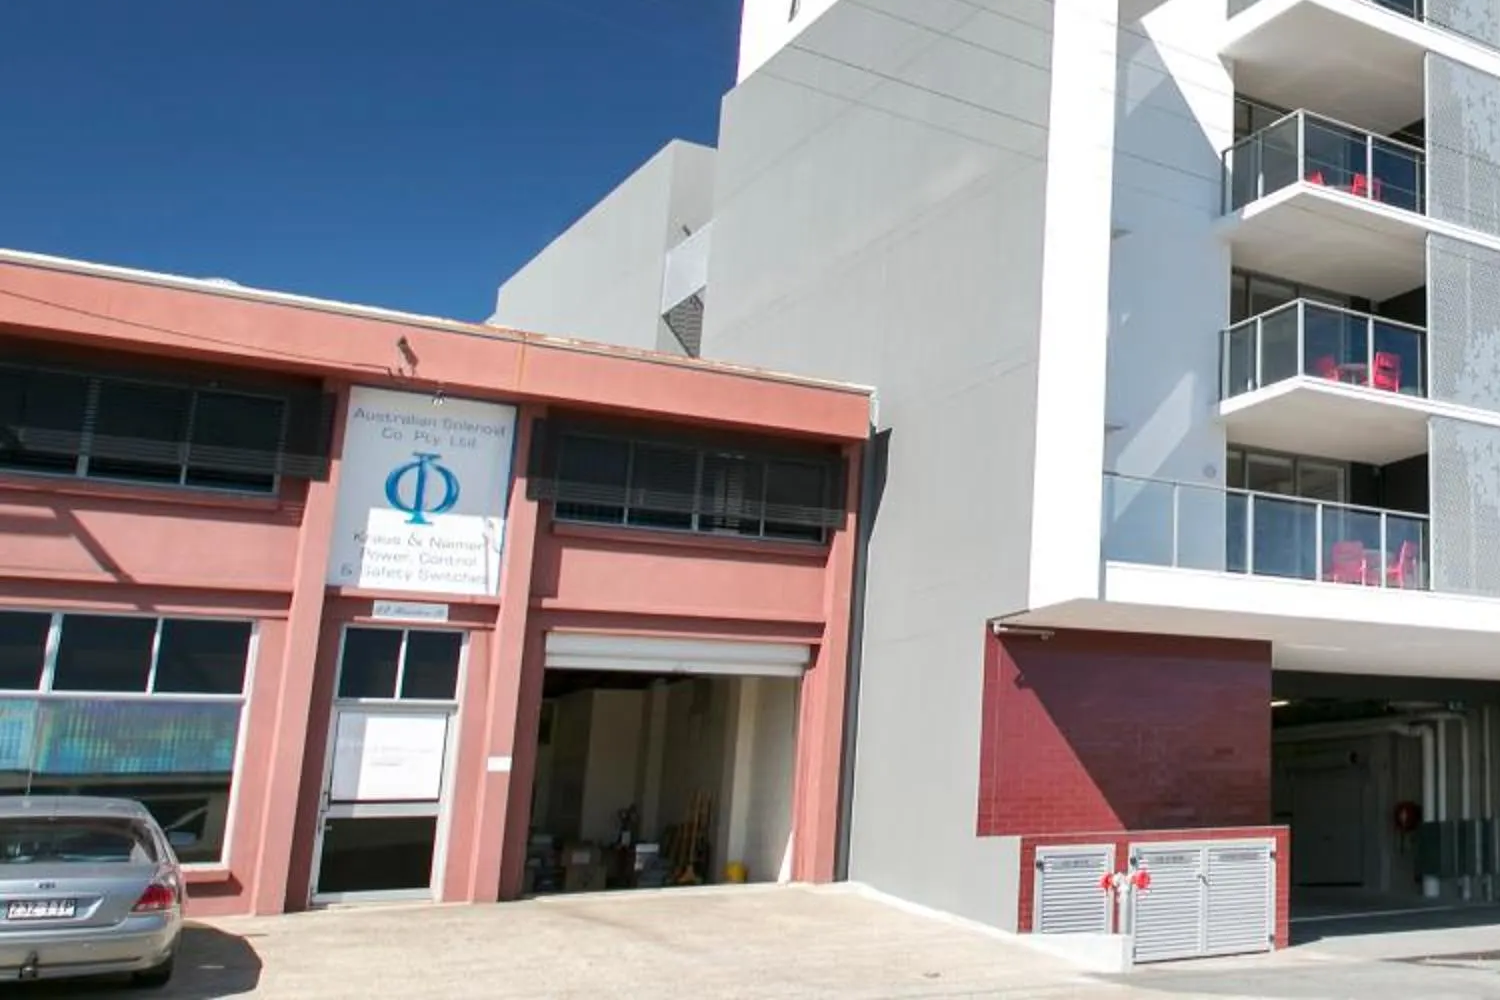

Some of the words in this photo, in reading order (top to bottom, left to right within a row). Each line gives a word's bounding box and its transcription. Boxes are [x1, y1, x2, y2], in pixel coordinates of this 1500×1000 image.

[353, 407, 437, 429] Australian
[414, 429, 440, 447] Pty
[450, 435, 477, 448] Ltd
[407, 531, 423, 547] &
[418, 551, 477, 567] Control
